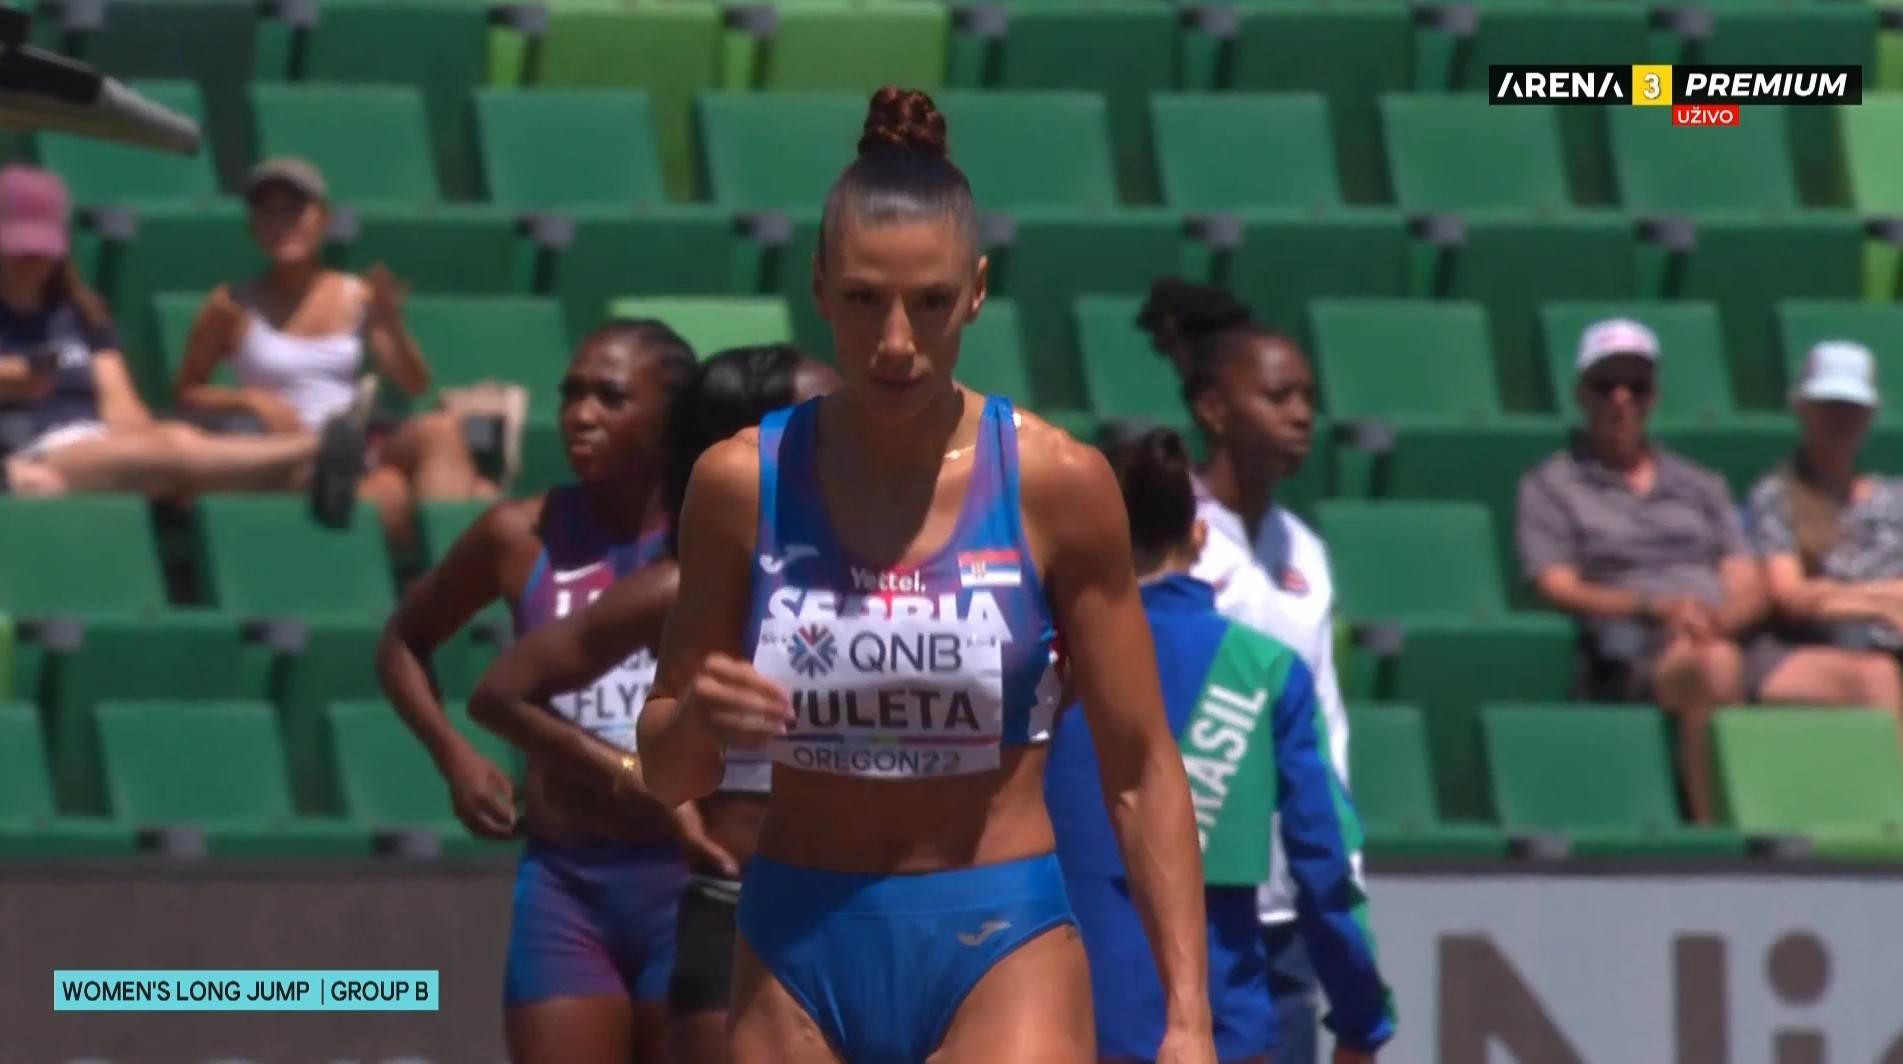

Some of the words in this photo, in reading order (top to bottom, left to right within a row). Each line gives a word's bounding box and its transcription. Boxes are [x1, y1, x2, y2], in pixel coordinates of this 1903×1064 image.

[850, 632, 962, 673] QNB
[574, 683, 652, 723] FLY
[793, 747, 960, 773] OREGON22
[1182, 684, 1268, 850] ASIL
